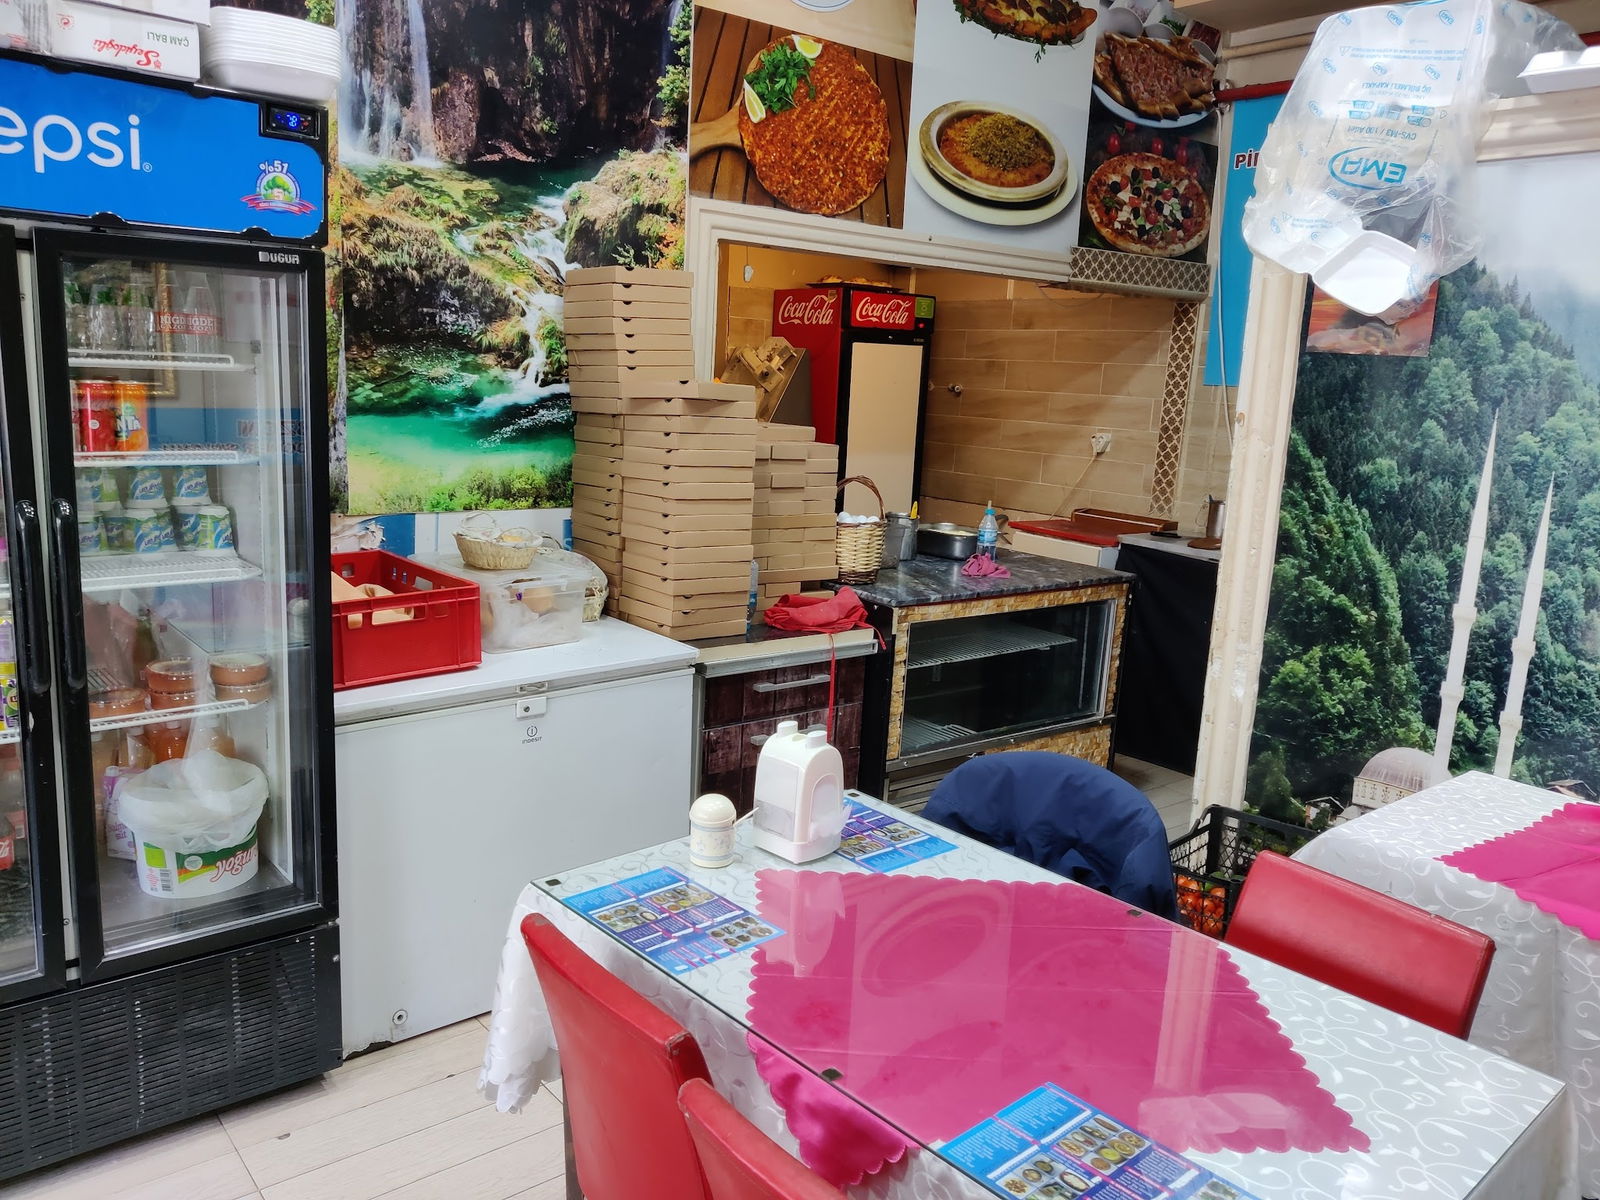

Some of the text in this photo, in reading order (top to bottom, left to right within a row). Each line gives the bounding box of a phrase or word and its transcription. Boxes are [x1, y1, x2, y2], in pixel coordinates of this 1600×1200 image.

[146, 31, 190, 47] ÇAM BALI
[258, 160, 289, 174] %51
[1339, 157, 1407, 184] EMA
[855, 296, 913, 325] Coca-Cola
